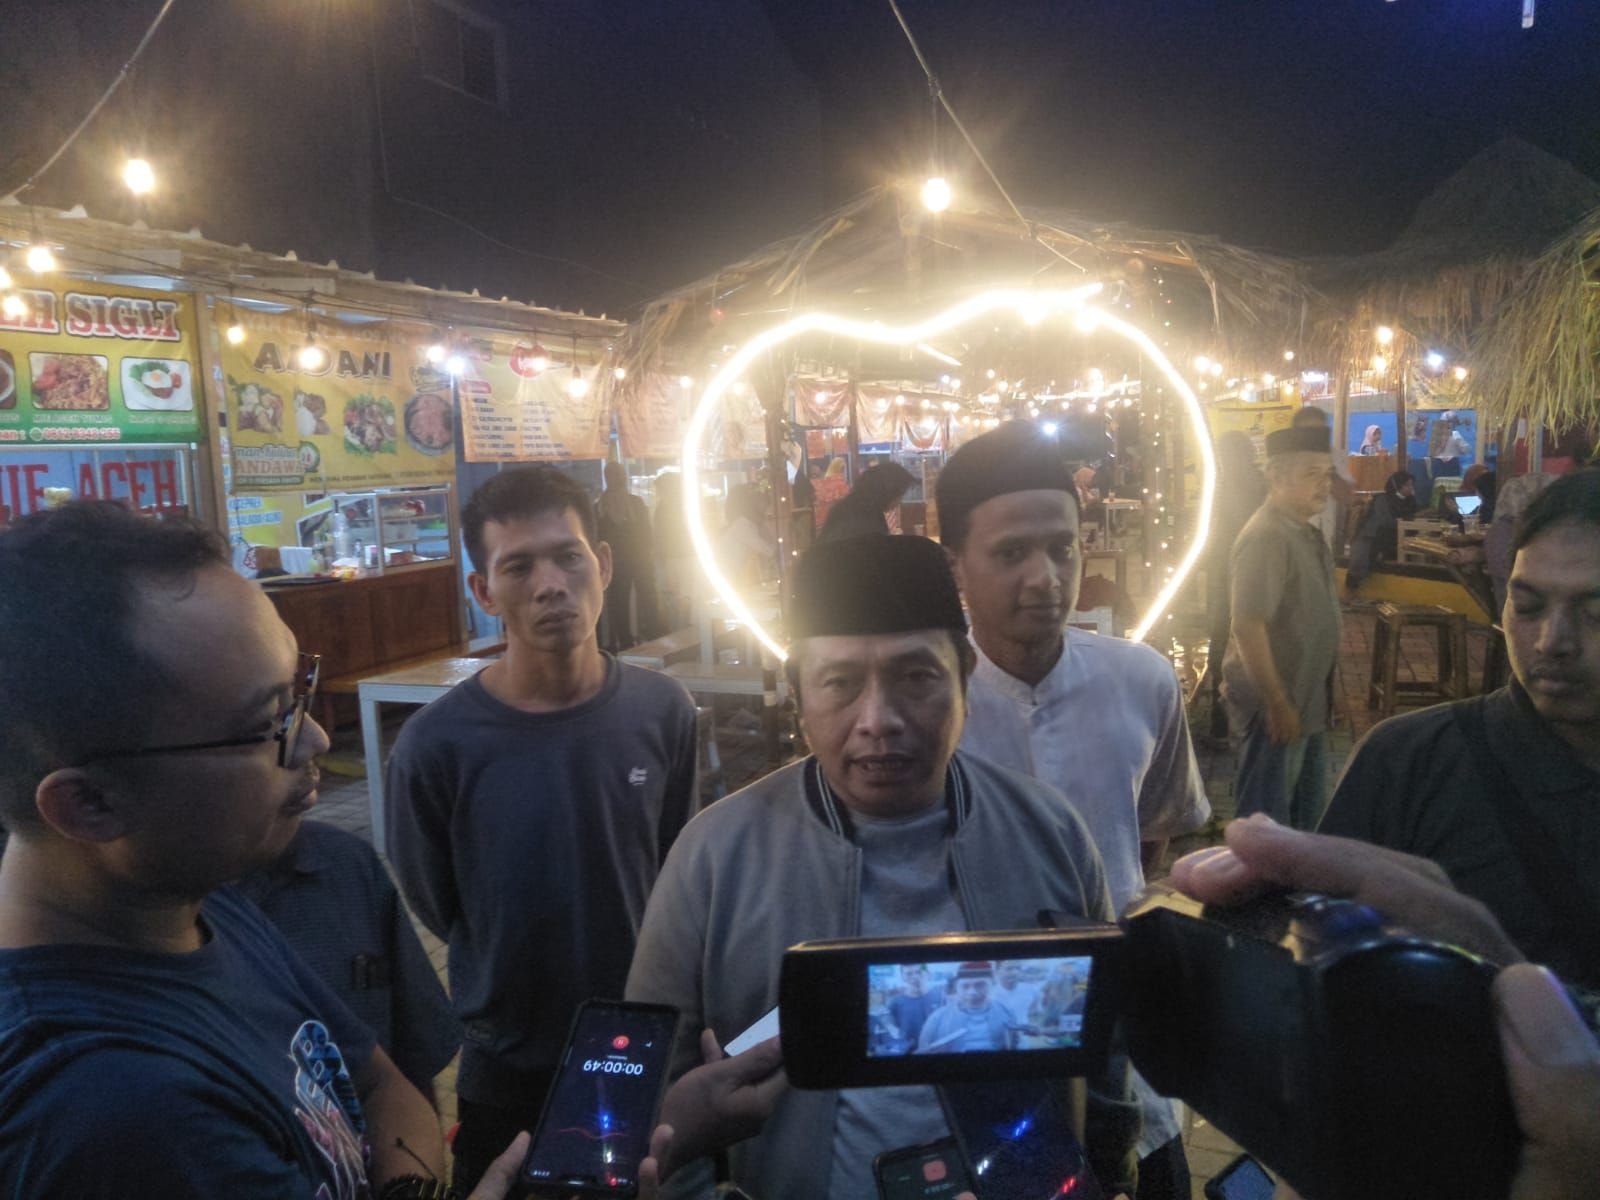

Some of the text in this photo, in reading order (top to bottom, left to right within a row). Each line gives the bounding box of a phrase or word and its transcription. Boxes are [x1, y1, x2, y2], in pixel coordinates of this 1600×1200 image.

[67, 294, 180, 340] SIGLI
[79, 457, 179, 514] ACEH
[583, 1060, 643, 1075] 00:00:49
